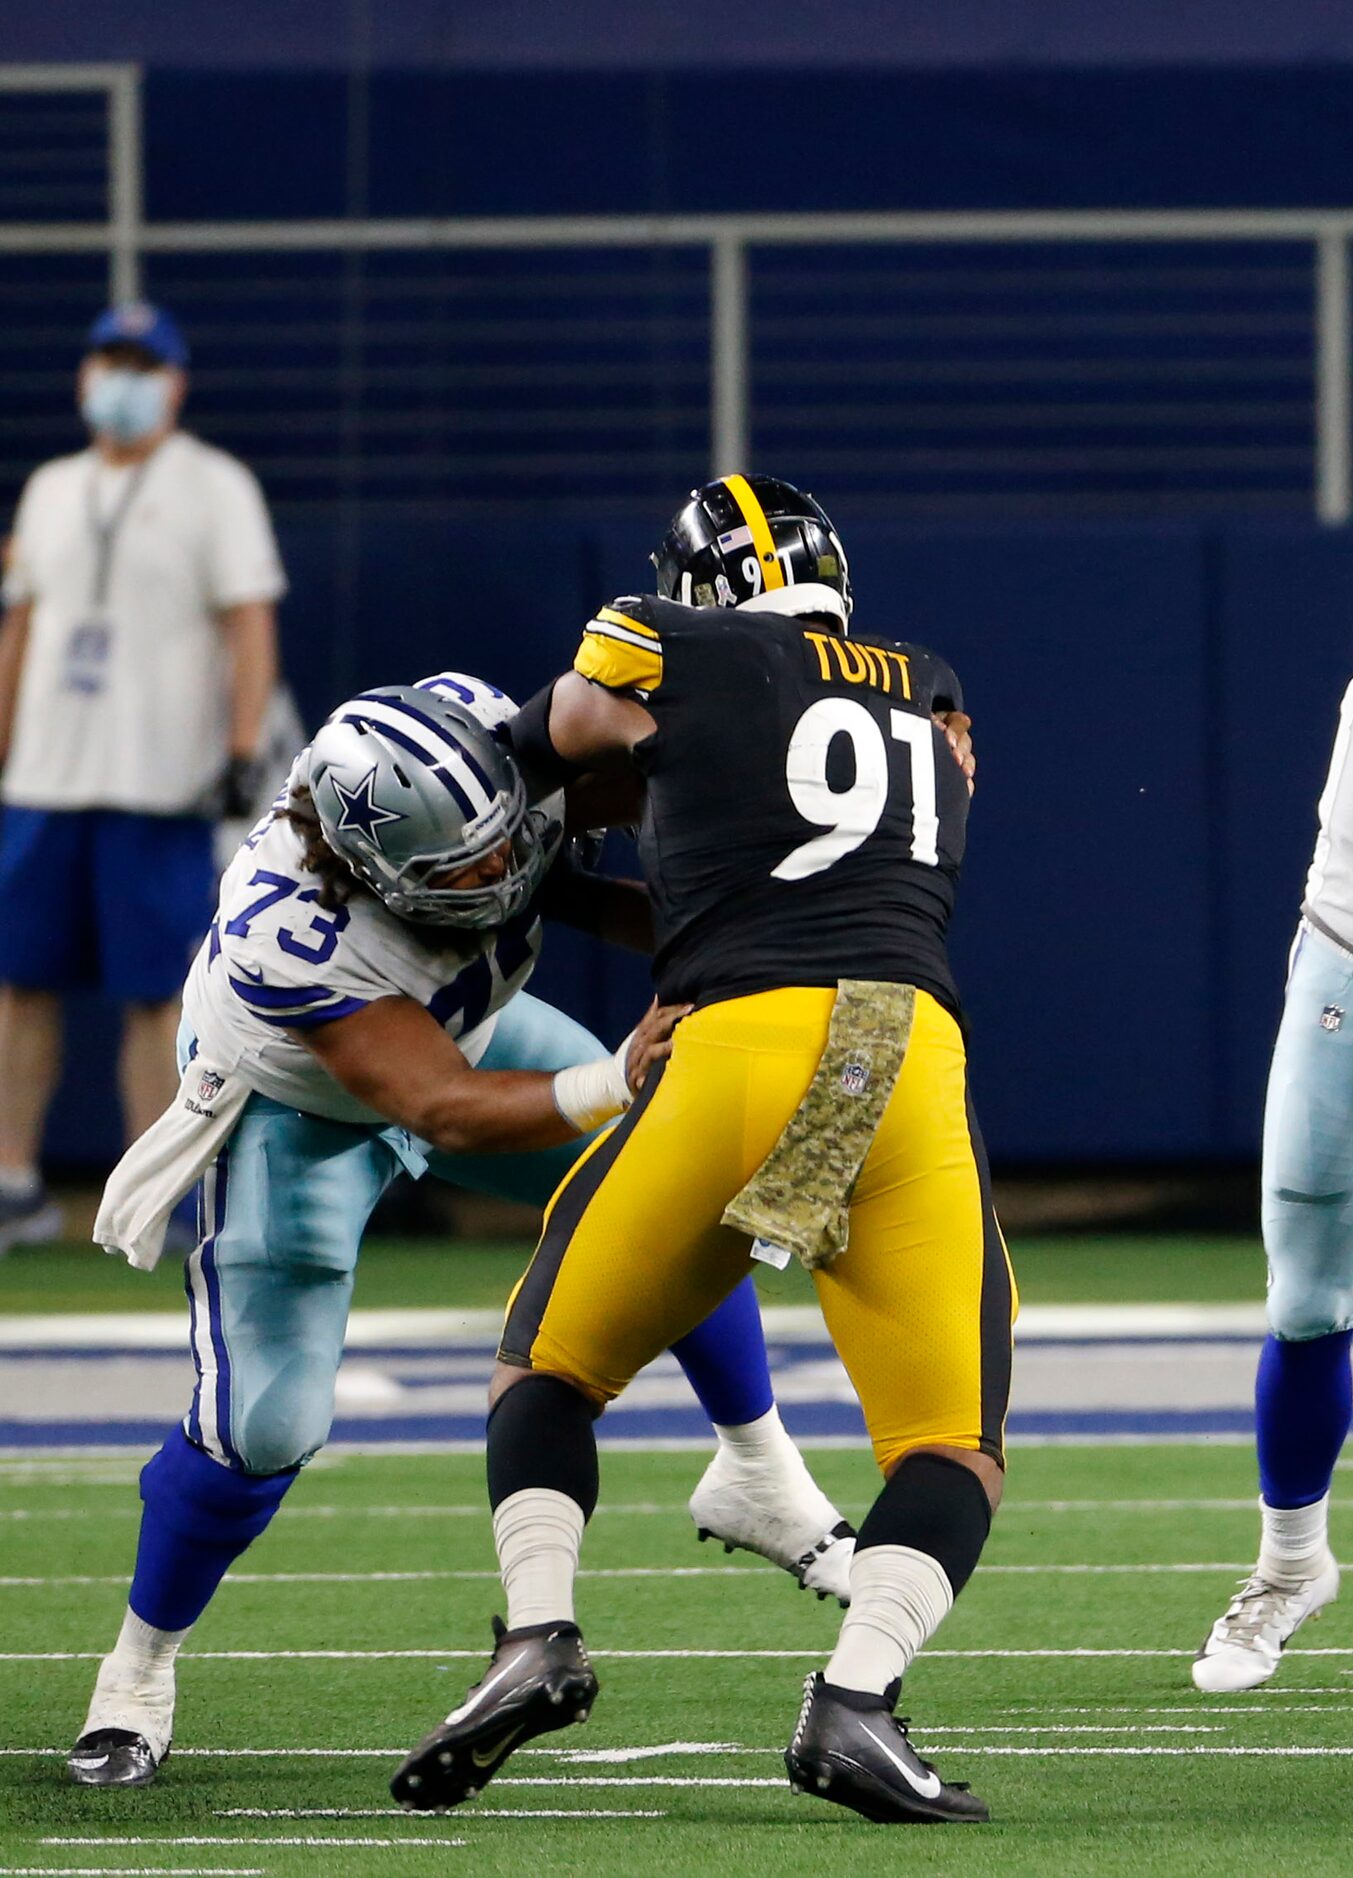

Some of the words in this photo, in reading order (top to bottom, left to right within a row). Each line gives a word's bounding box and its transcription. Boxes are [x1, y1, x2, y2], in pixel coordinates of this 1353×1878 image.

[742, 549, 795, 597] 91
[803, 631, 912, 700] TUITT
[770, 697, 940, 881] 91
[225, 869, 351, 966] 73
